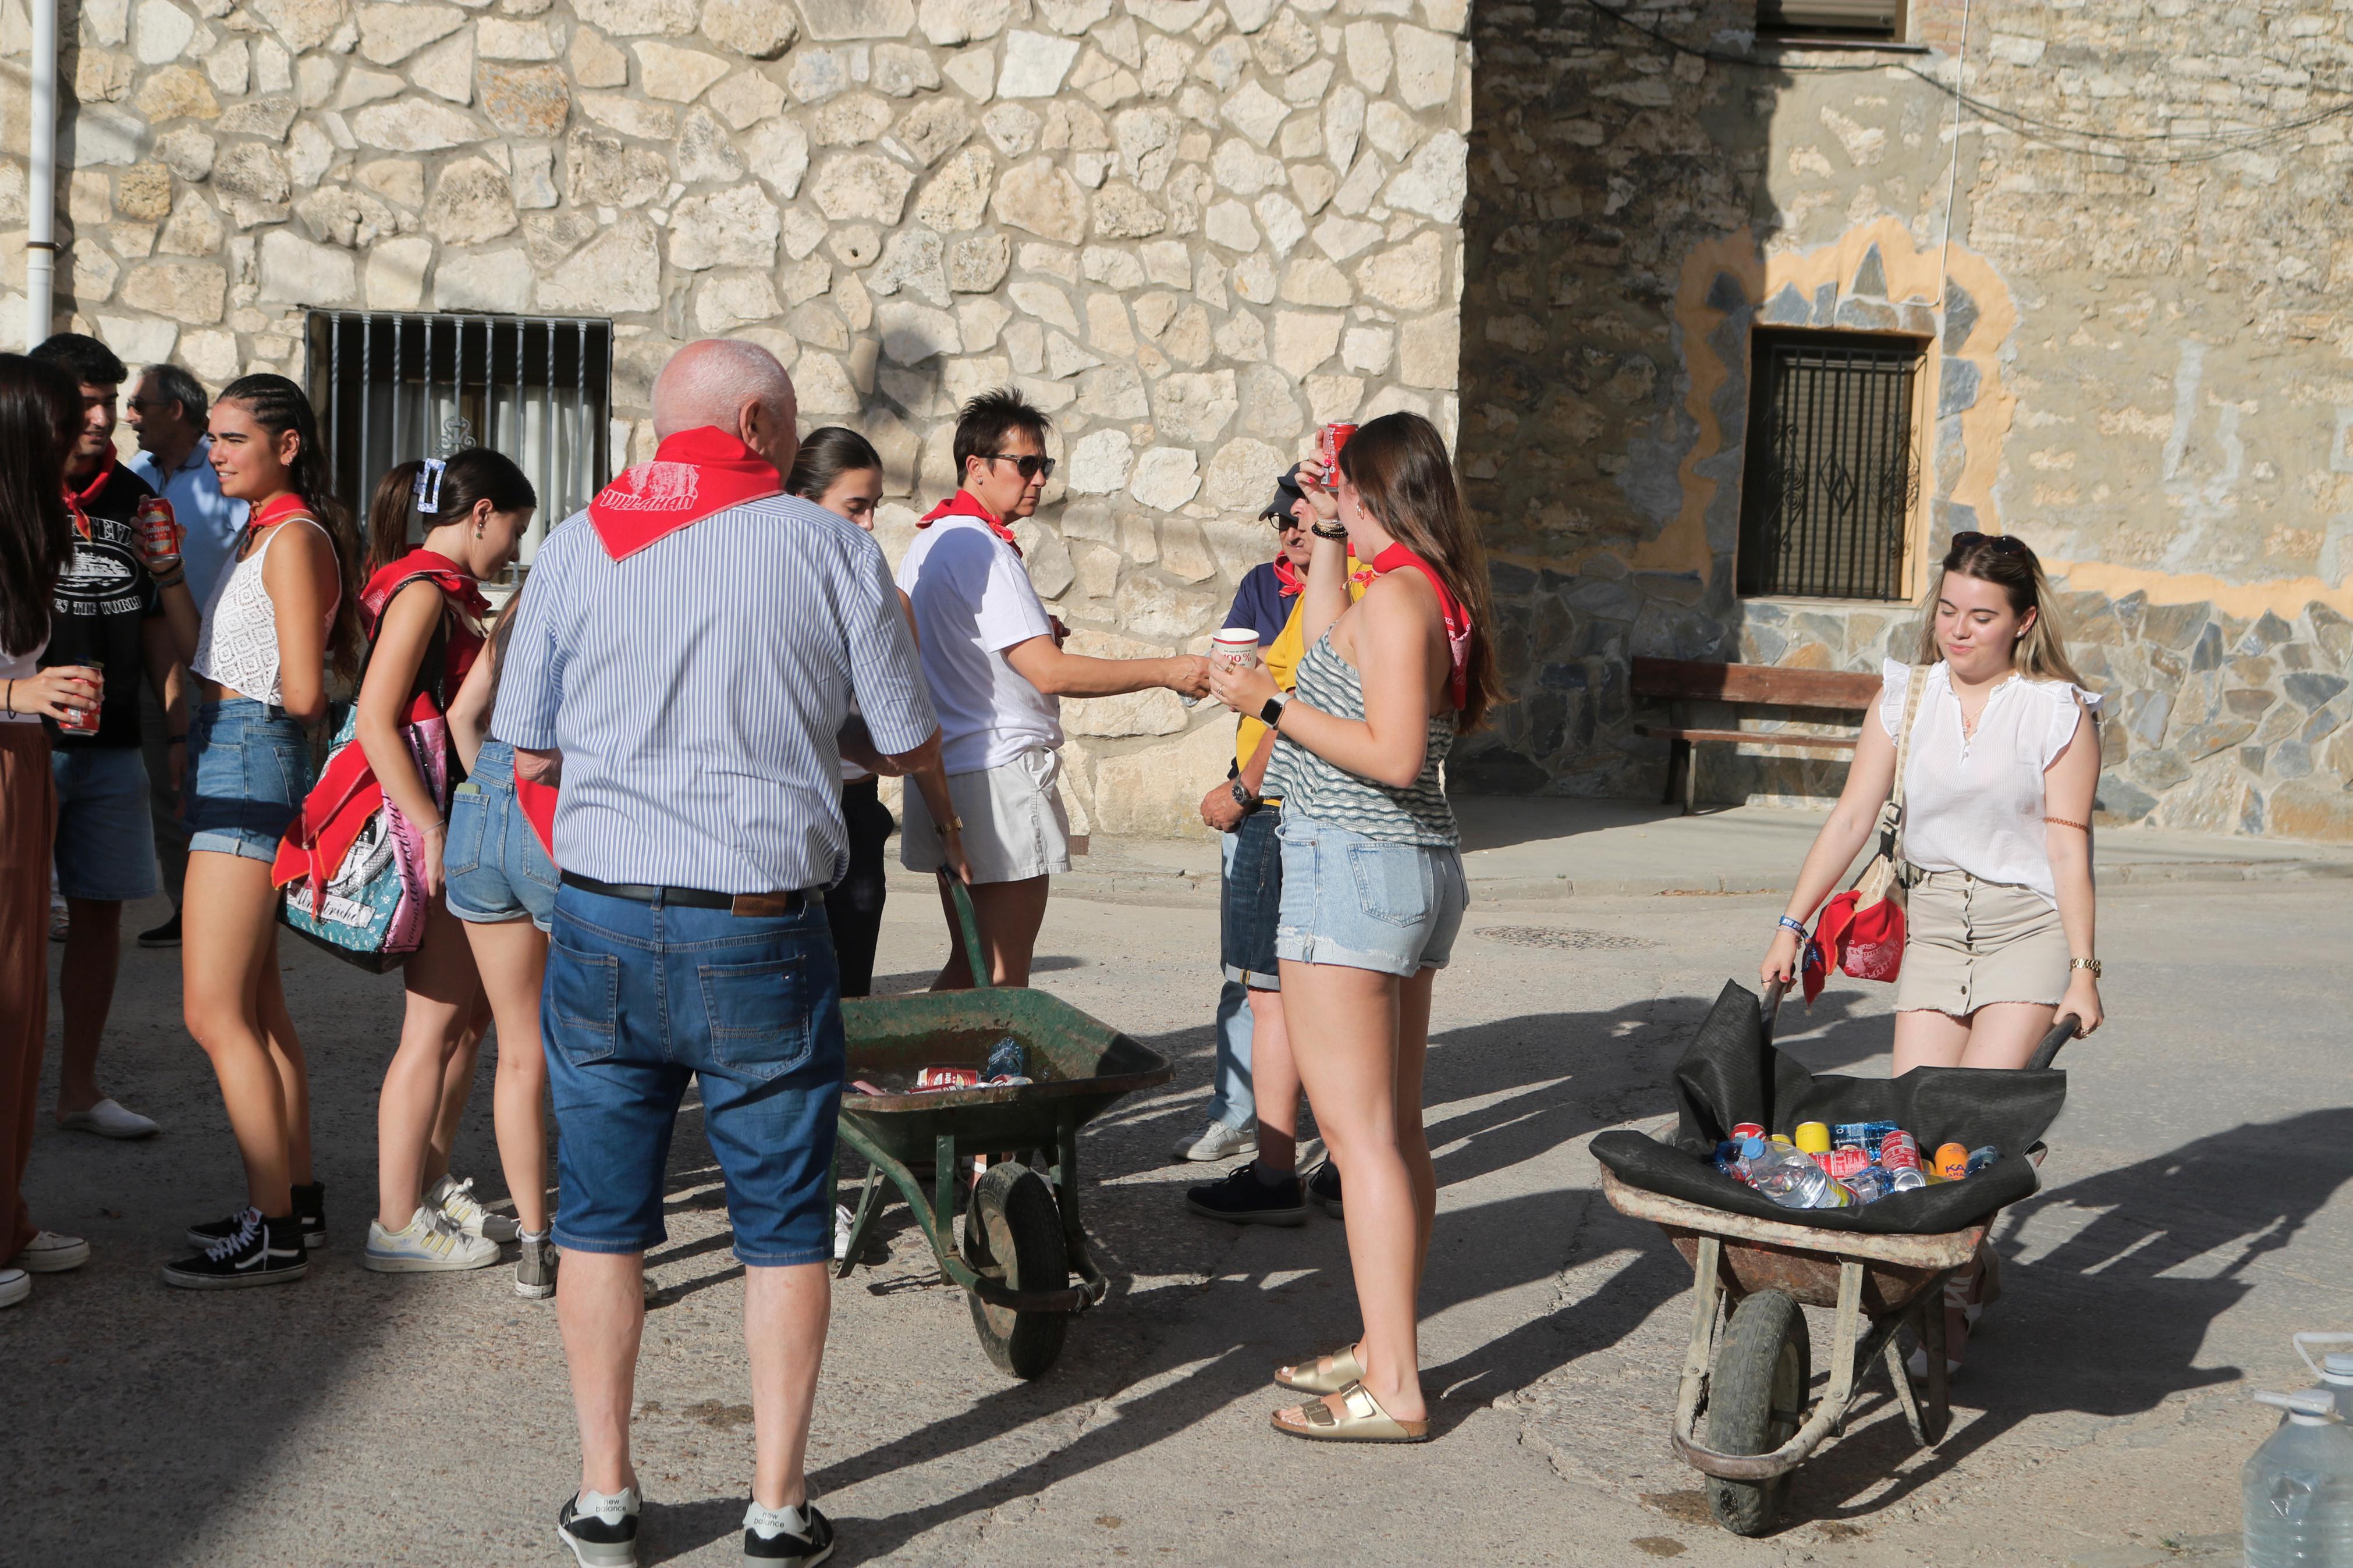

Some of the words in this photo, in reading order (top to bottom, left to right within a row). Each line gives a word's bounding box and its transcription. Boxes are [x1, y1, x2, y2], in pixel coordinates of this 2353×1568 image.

[73, 600, 96, 616] THE
[100, 595, 143, 614] WORLD
[1782, 918, 1794, 926] BYE
[754, 1517, 785, 1528] balance
